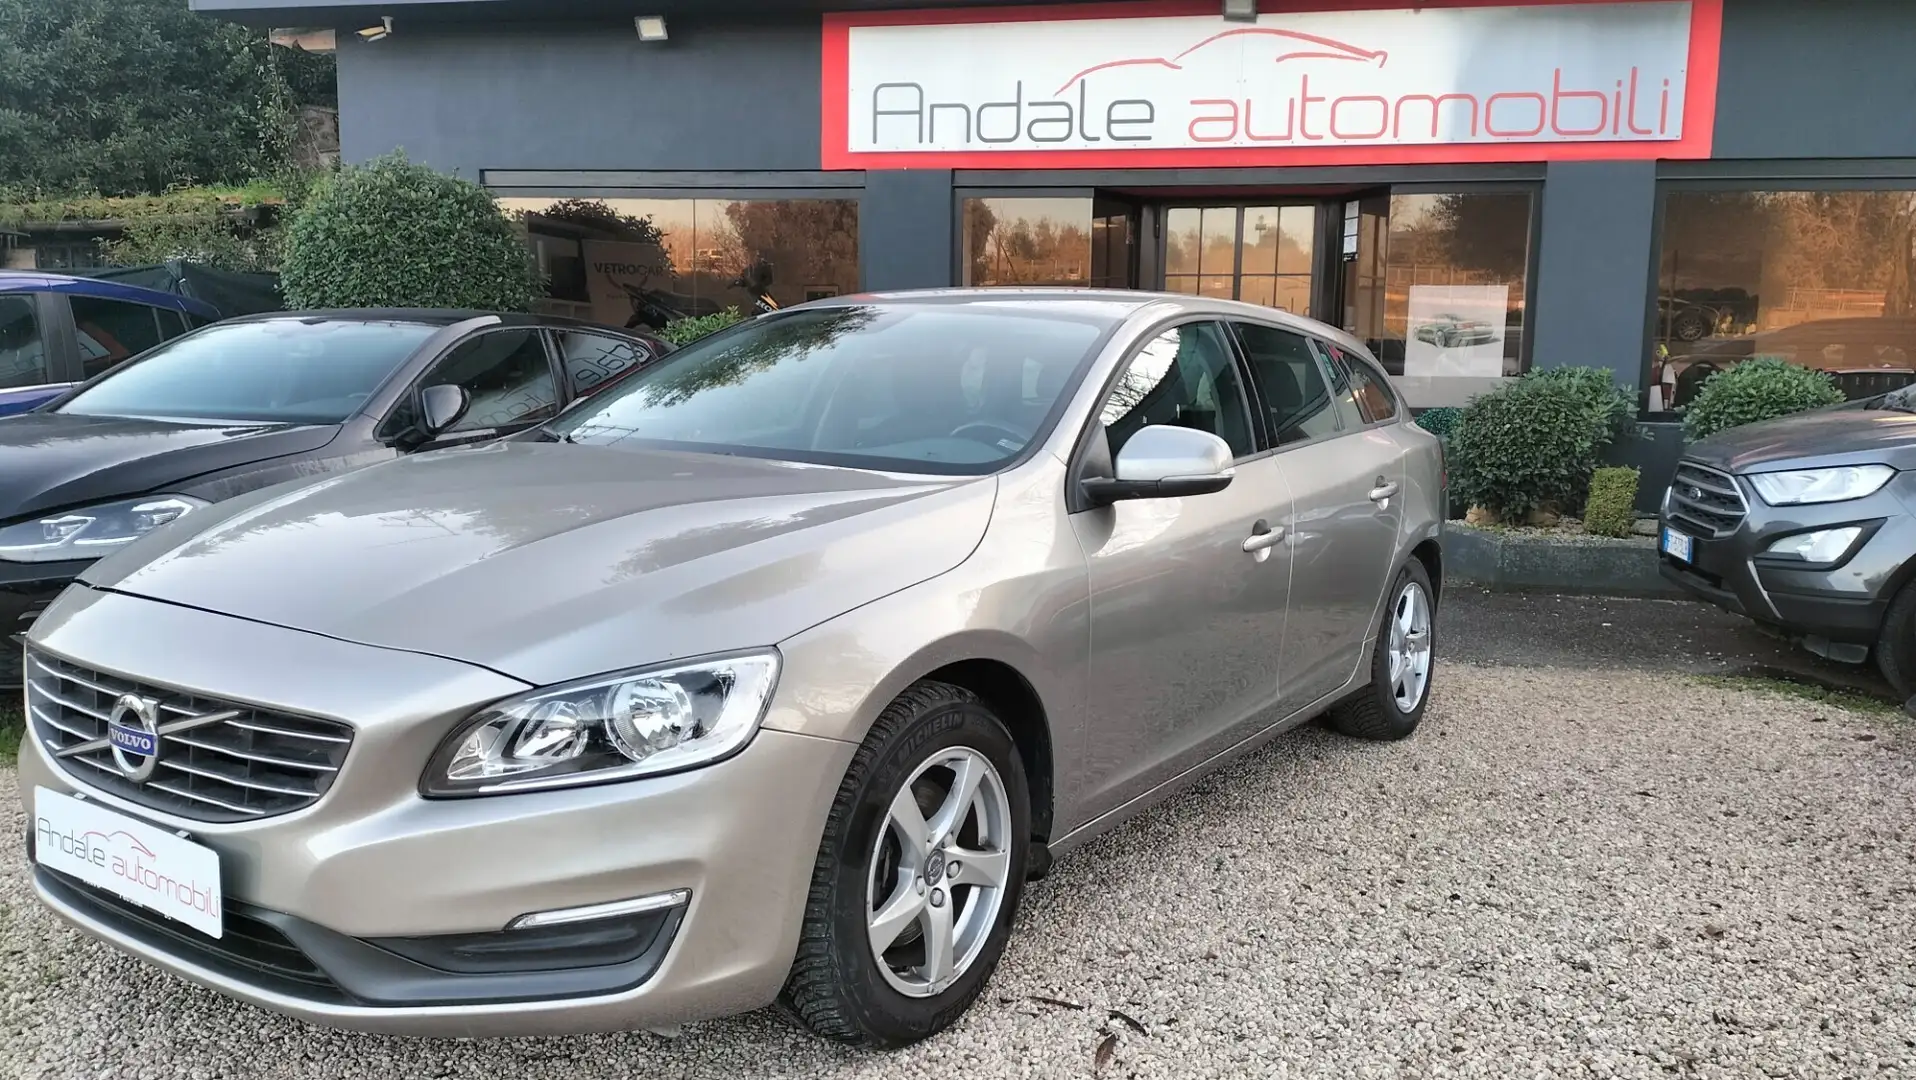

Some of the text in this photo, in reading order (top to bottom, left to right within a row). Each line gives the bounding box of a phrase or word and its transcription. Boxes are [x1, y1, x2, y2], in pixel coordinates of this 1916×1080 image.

[872, 68, 1669, 145] Andale automobili
[110, 729, 151, 750] VOLVO
[898, 712, 964, 760] MICHELIN
[37, 817, 219, 919] Andale automobili
